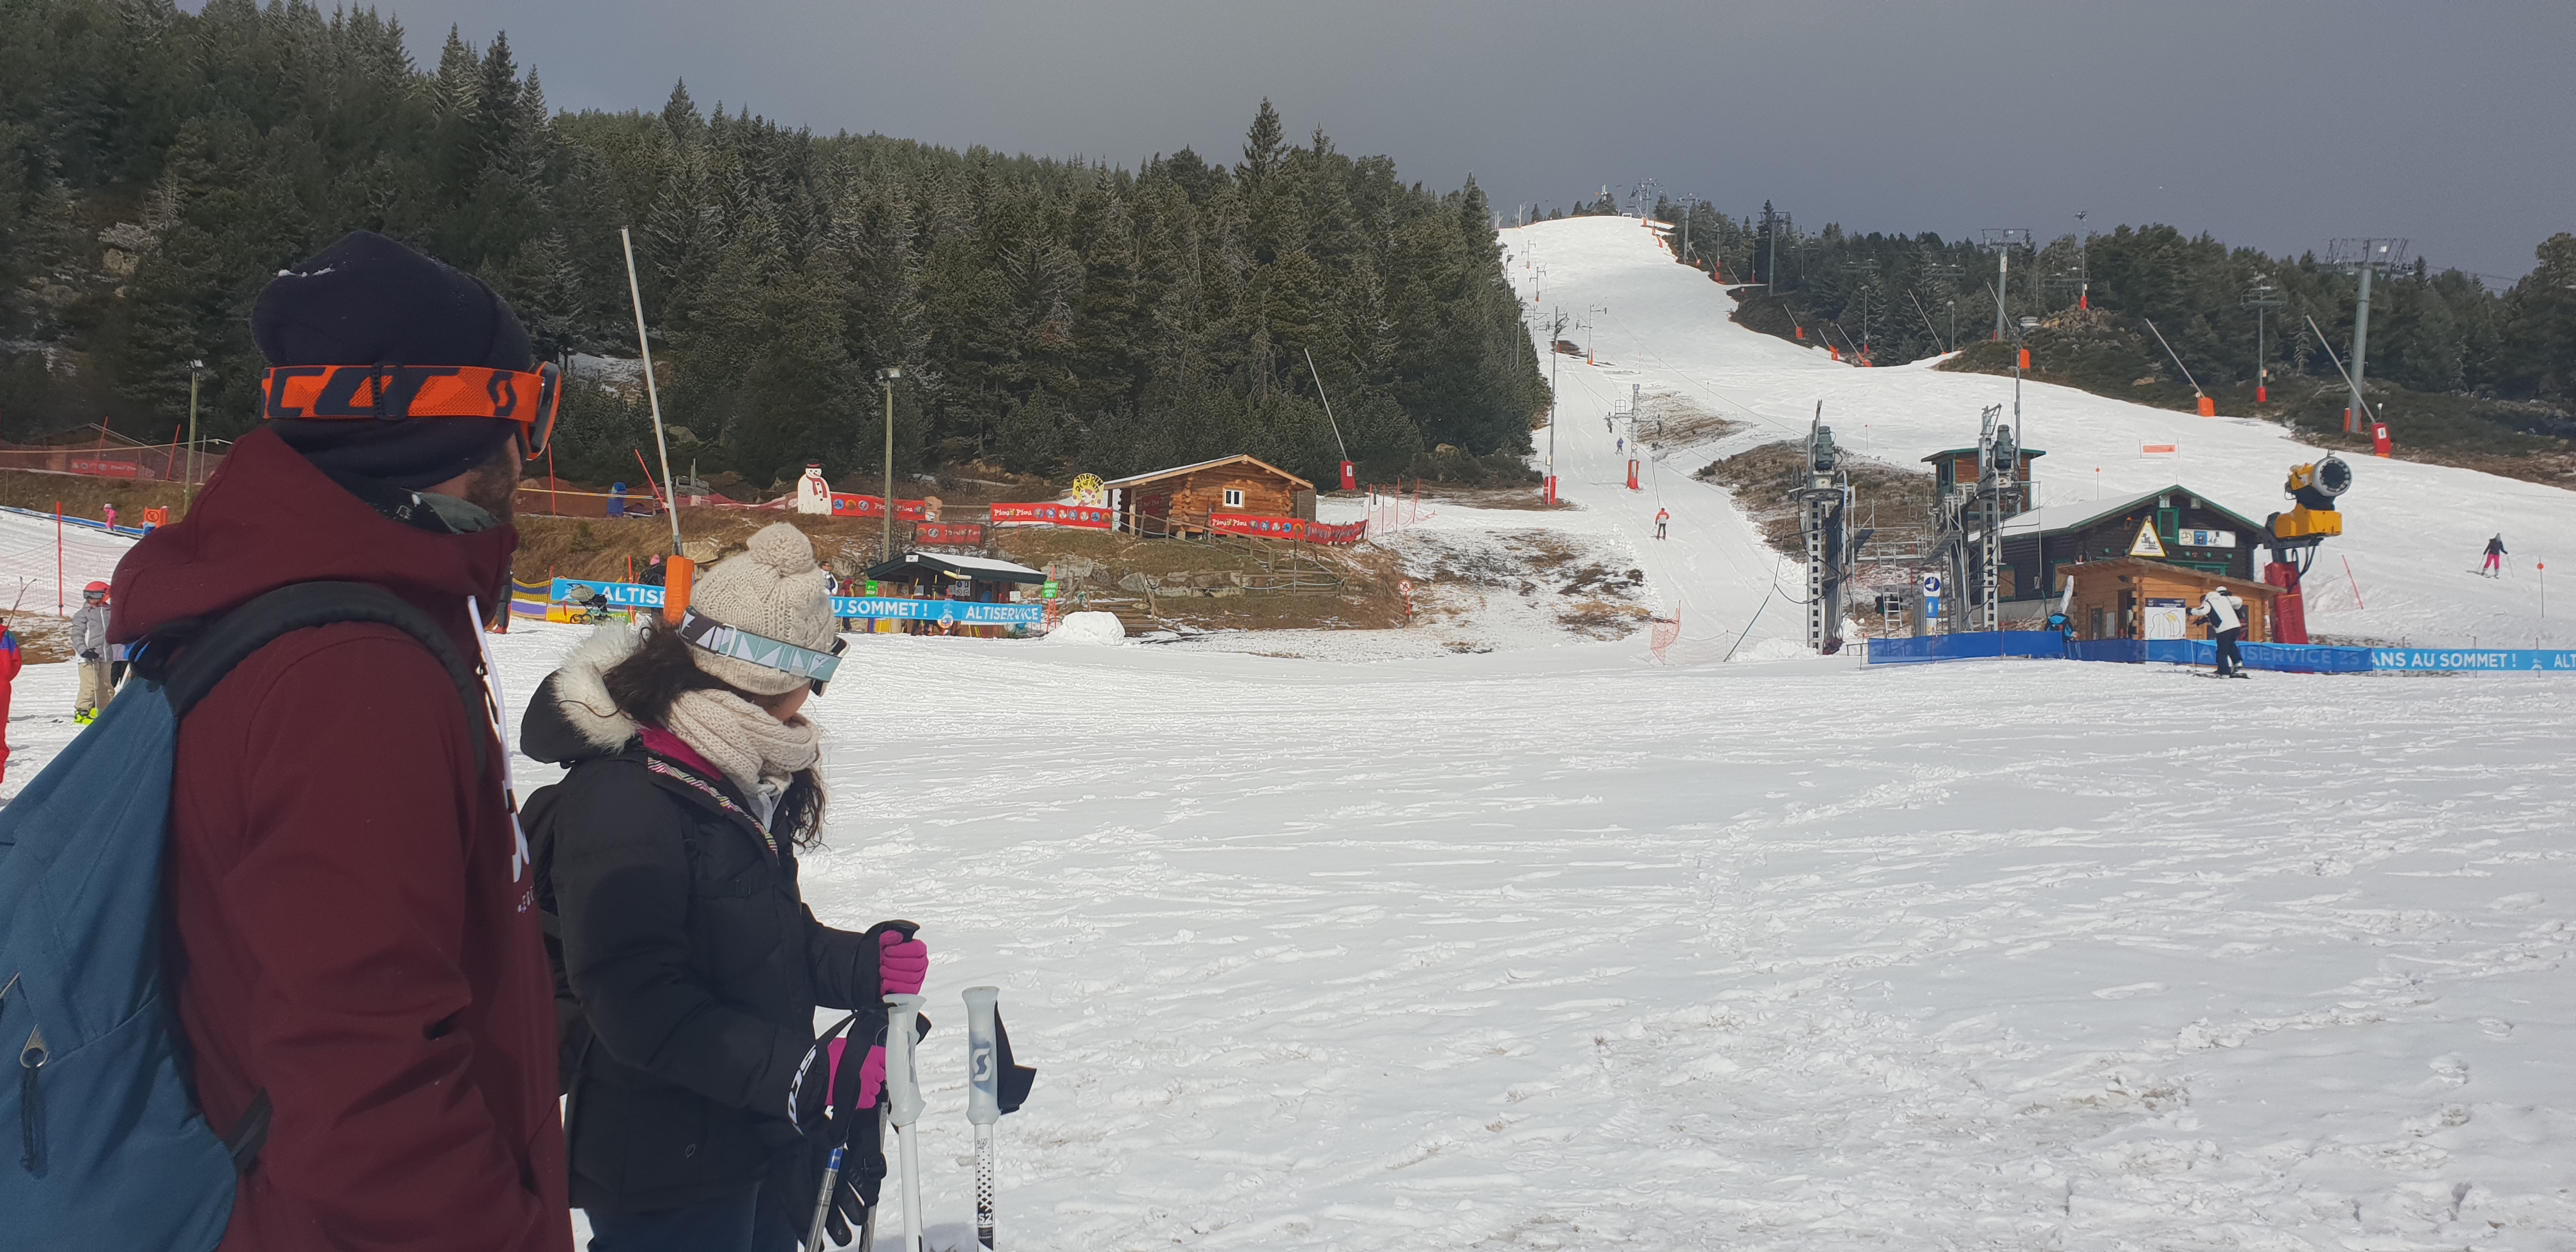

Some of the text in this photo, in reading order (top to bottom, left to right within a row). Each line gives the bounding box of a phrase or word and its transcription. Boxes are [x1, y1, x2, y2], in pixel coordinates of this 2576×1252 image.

[1075, 474, 1103, 486] JARDIN
[847, 600, 919, 616] SOMMET
[965, 605, 1038, 620] ALTISERVICE
[2198, 645, 2331, 664] AISERVICE
[2367, 652, 2406, 667] ANS
[2411, 652, 2435, 667] AU
[2439, 653, 2508, 668] SOMMET
[978, 1212, 992, 1223] S2
